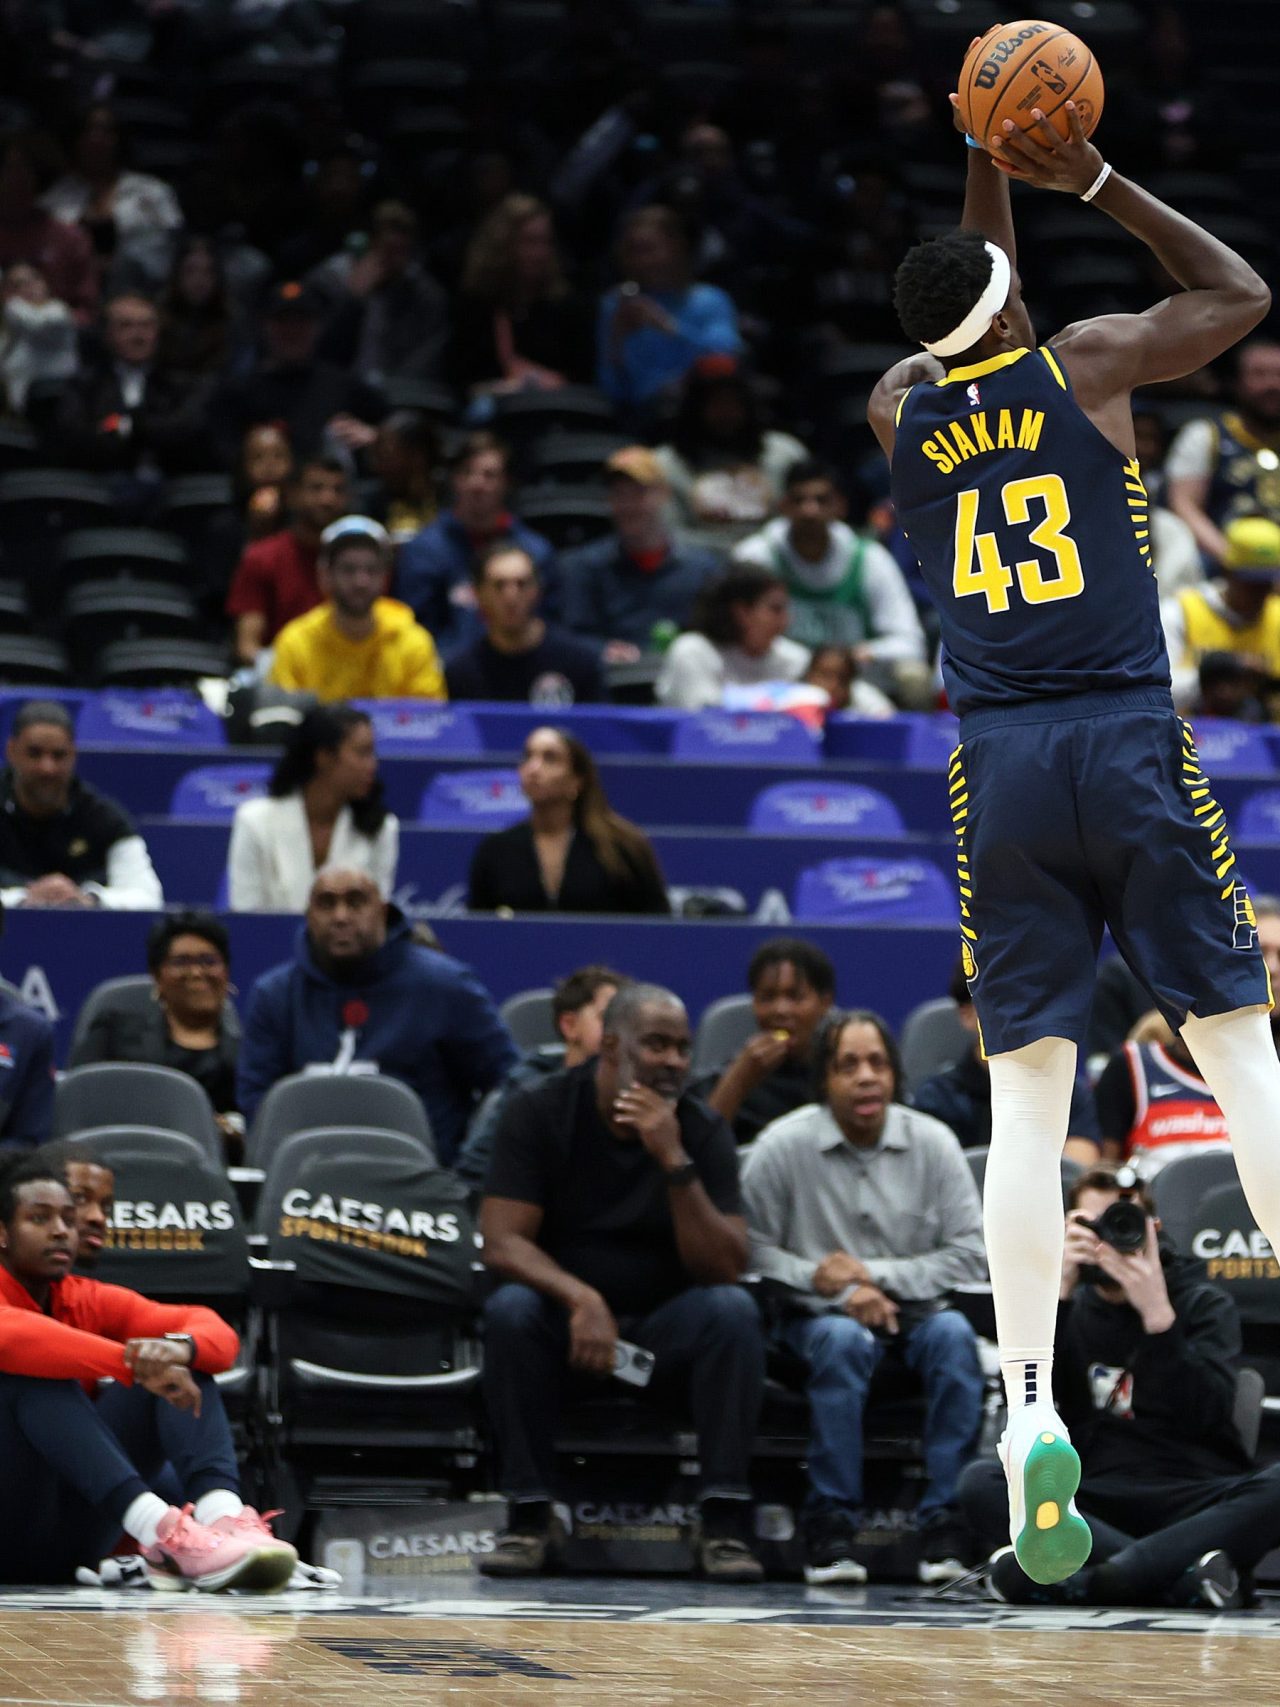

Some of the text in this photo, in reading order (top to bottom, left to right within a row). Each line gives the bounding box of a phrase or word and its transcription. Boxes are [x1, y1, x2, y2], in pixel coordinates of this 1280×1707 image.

[974, 24, 1049, 89] Wilson
[921, 408, 1045, 474] SIAKAM
[952, 473, 1085, 614] 43
[105, 1200, 235, 1230] ESARS
[281, 1188, 460, 1242] CAESARS
[368, 1530, 496, 1559] CAESARS
